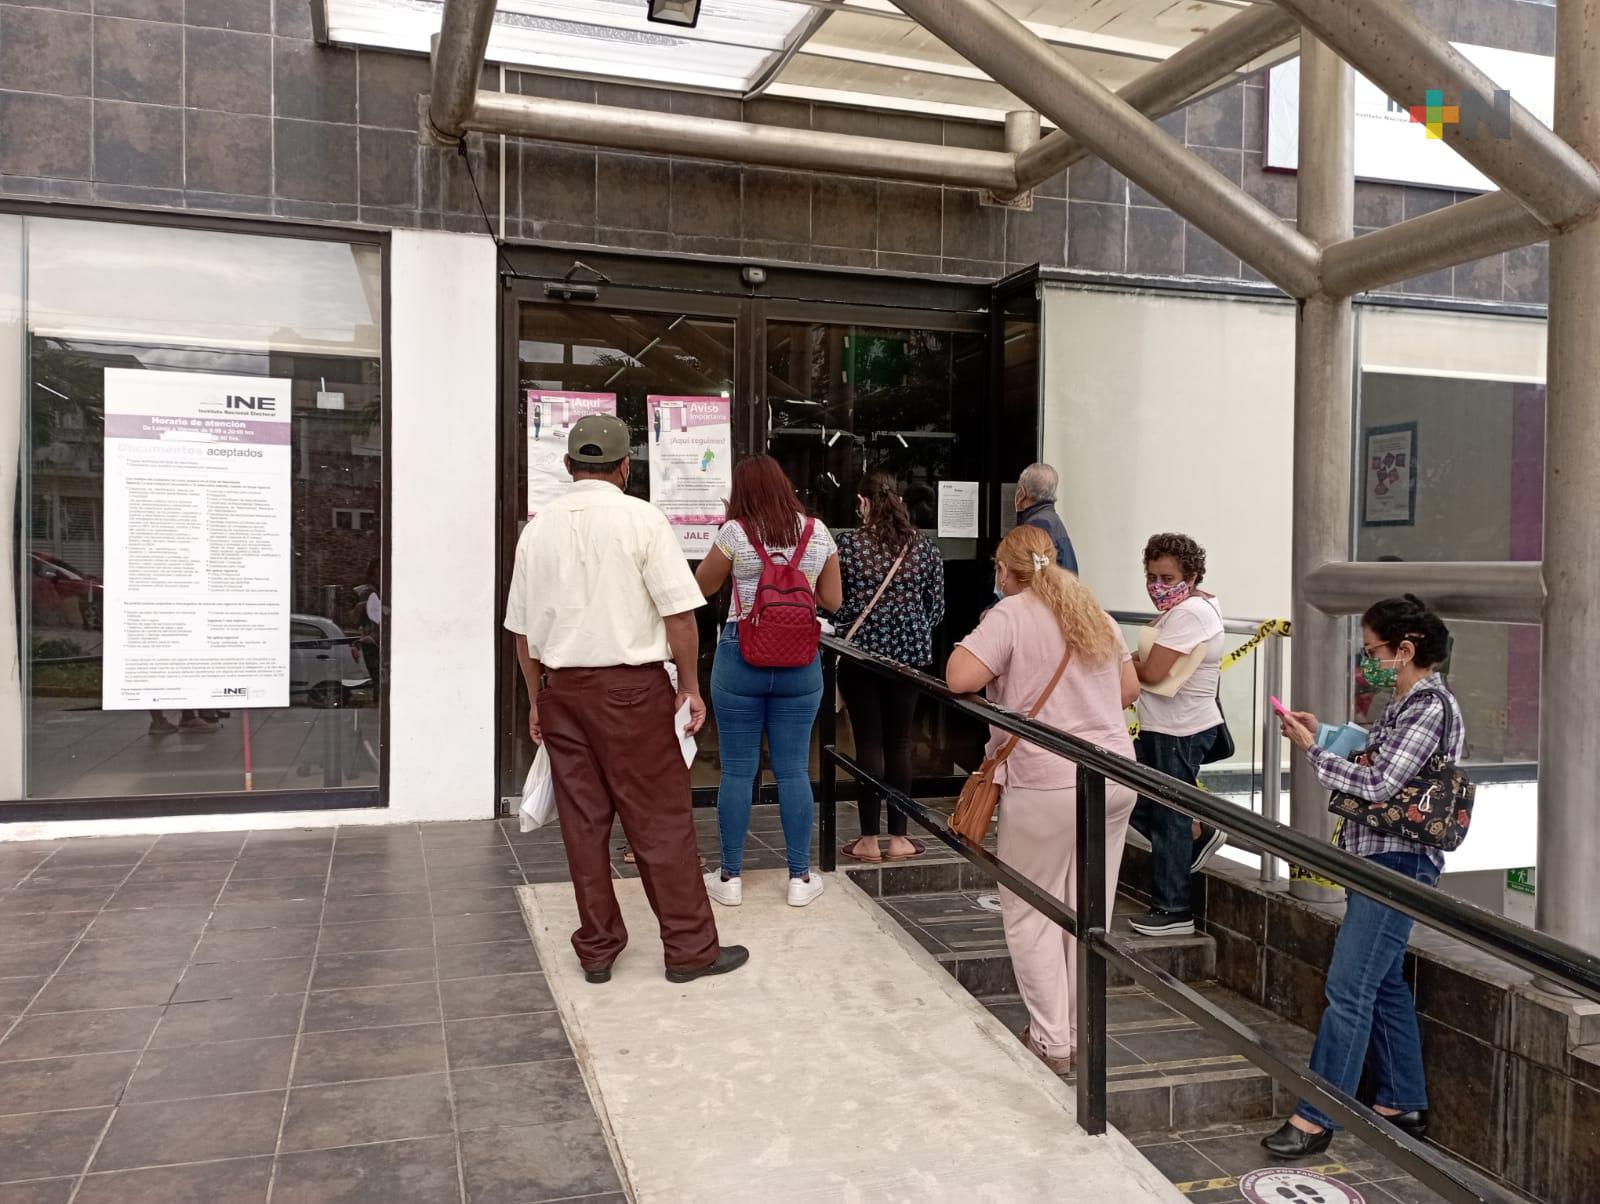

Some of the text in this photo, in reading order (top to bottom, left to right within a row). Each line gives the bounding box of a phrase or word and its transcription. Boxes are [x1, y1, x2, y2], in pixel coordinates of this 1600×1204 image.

[226, 395, 276, 411] INE
[690, 403, 719, 413] Aviso
[151, 416, 246, 428] Horario de atención
[206, 447, 263, 459] aceptados
[683, 531, 710, 540] JALE
[223, 687, 247, 695] INE
